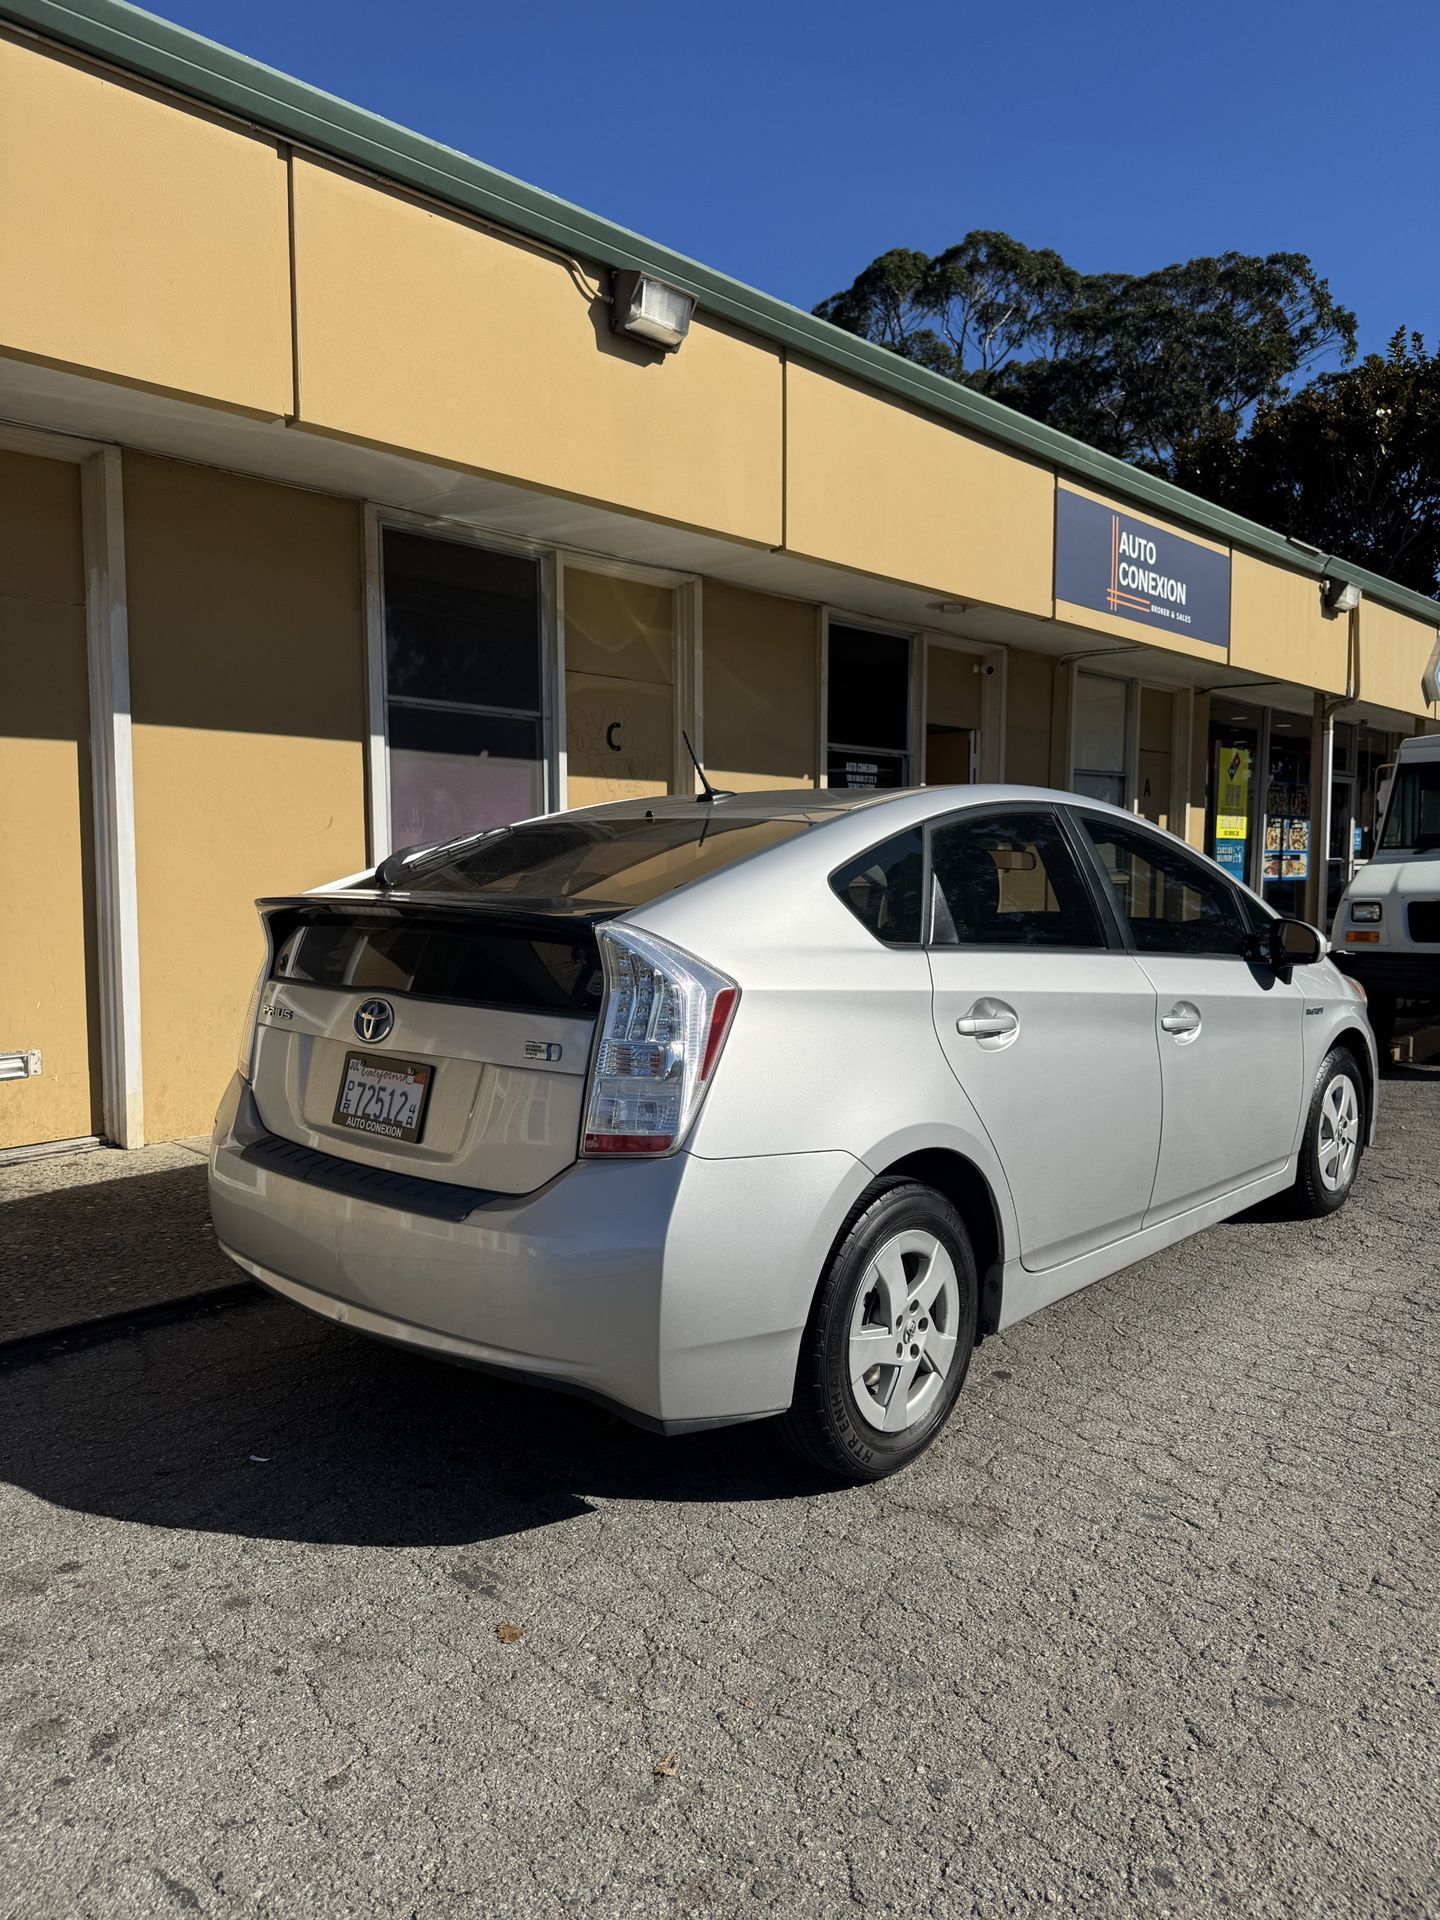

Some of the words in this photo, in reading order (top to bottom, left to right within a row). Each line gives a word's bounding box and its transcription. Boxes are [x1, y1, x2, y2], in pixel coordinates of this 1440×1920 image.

[1119, 531, 1157, 565] AUTO
[1119, 562, 1187, 606] CONEXION
[1151, 604, 1170, 617] BROKER
[1171, 611, 1175, 619] &
[1176, 613, 1191, 623] SALES
[606, 722, 621, 751] C
[1143, 779, 1151, 797] A
[263, 1005, 294, 1019] PRIUS
[355, 1082, 408, 1126] 72512
[346, 1116, 365, 1129] AUTO
[366, 1120, 402, 1138] CONEXION
[847, 1434, 874, 1463] HTR
